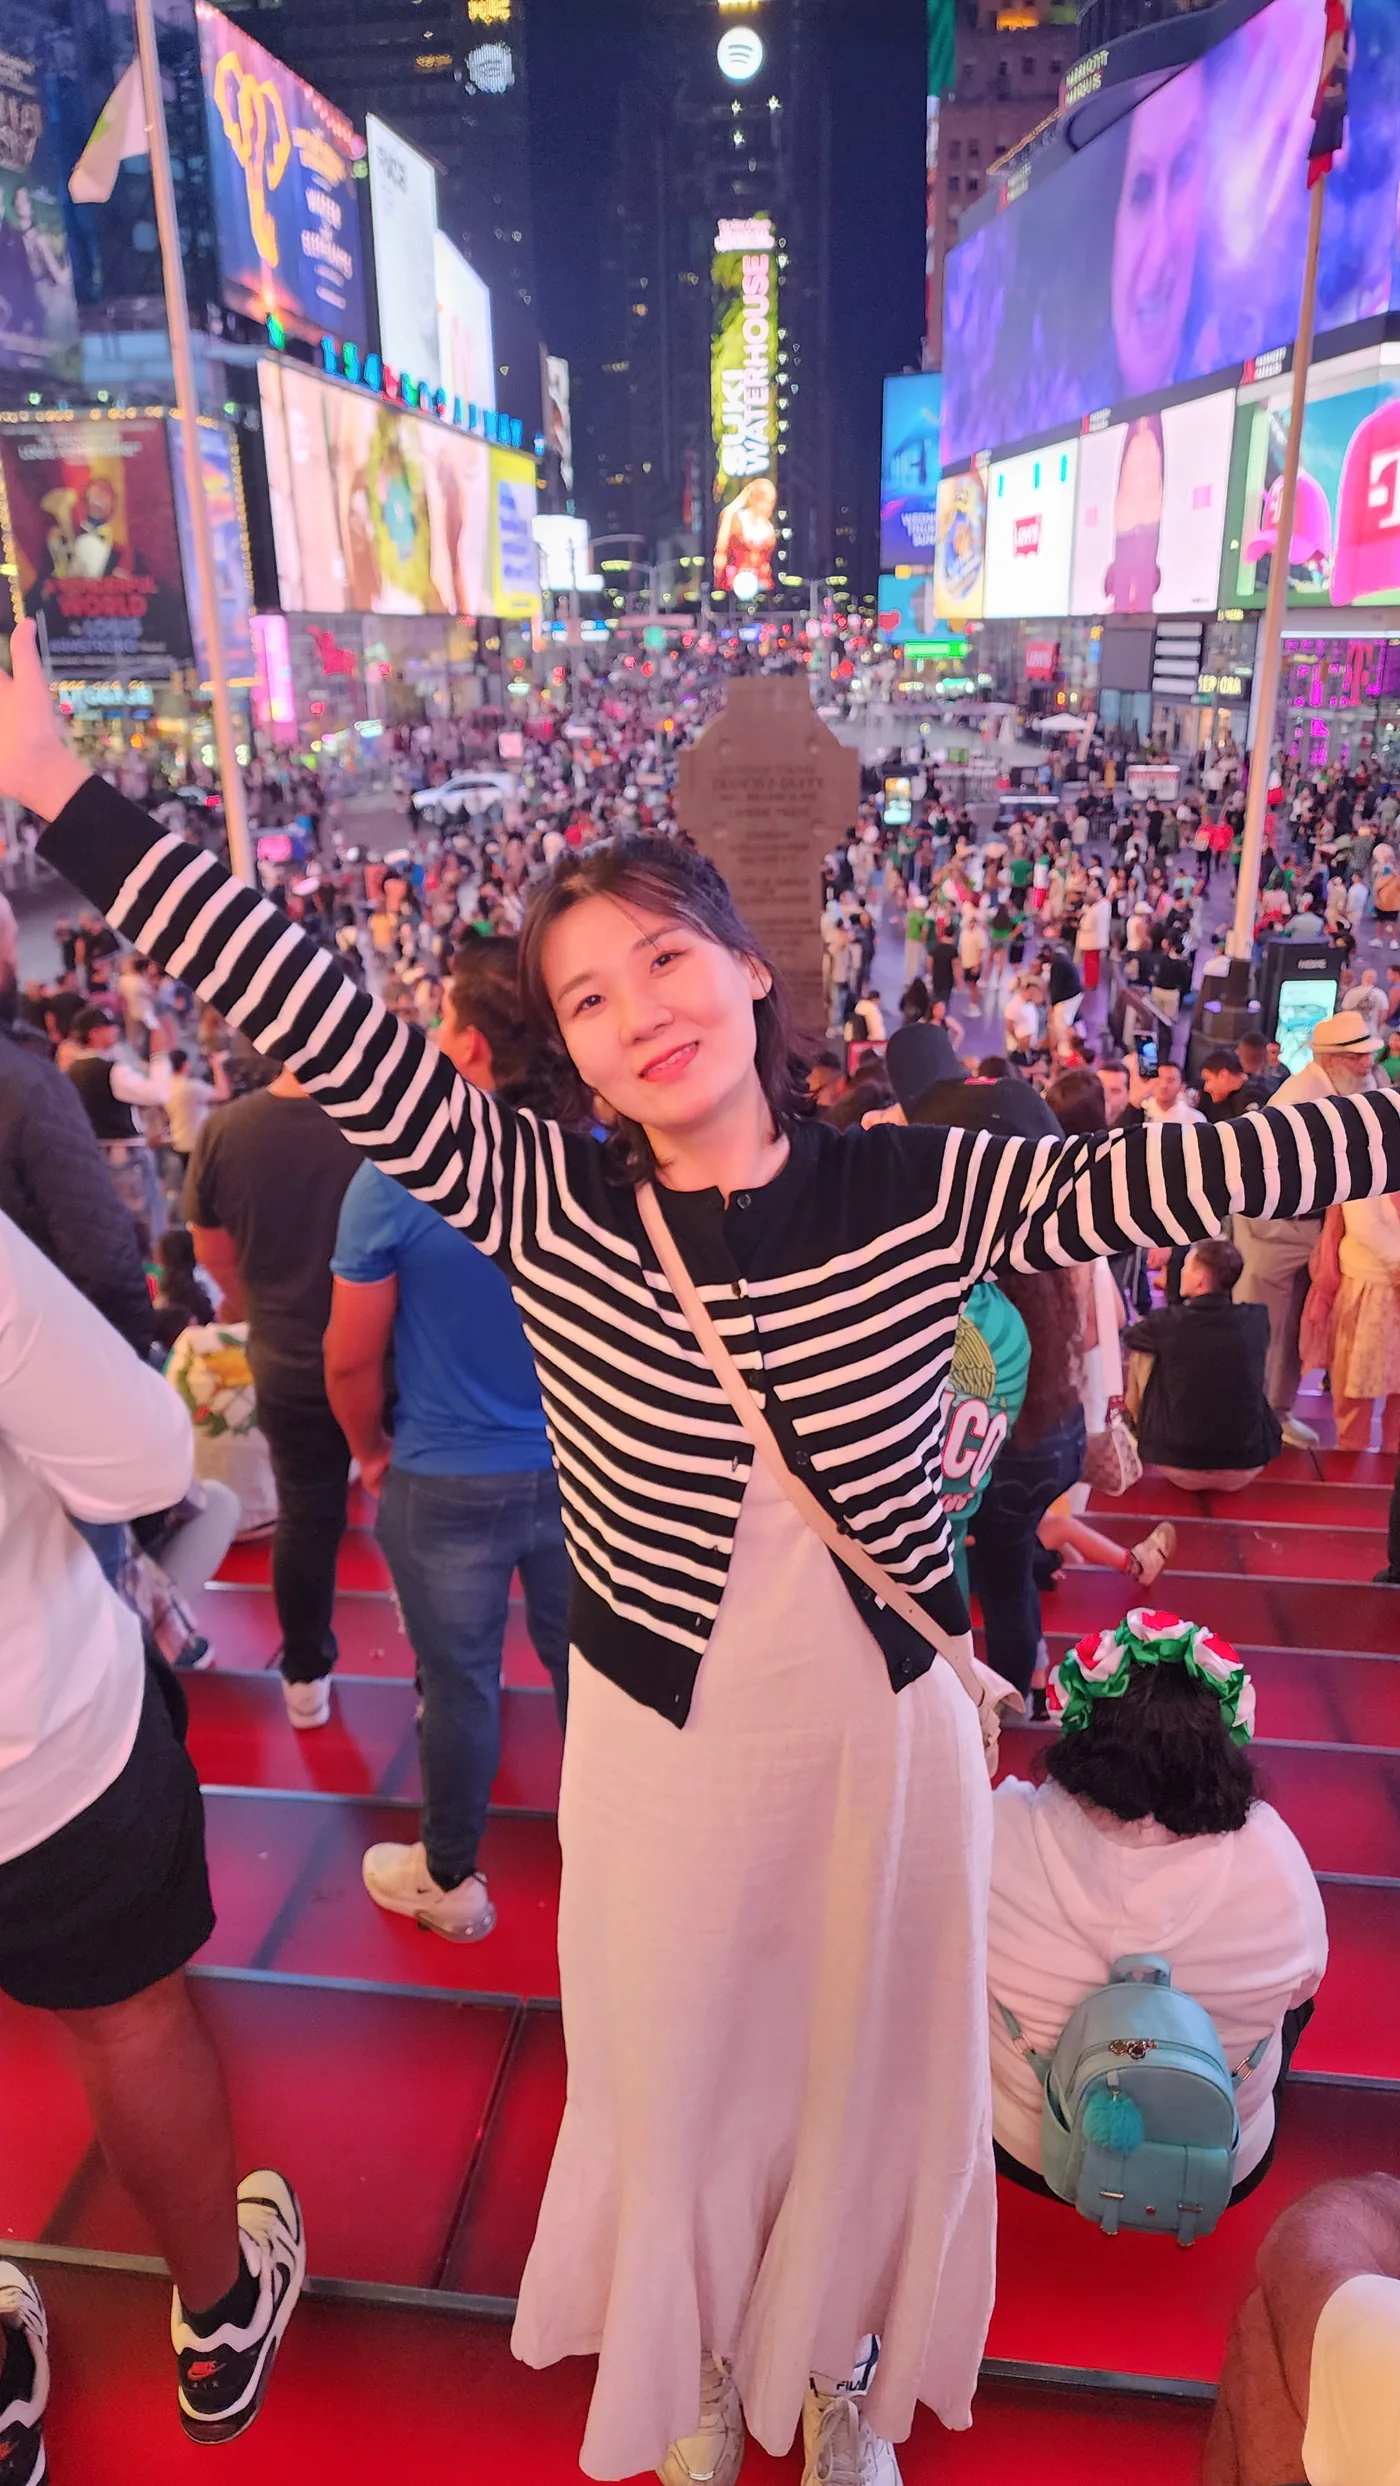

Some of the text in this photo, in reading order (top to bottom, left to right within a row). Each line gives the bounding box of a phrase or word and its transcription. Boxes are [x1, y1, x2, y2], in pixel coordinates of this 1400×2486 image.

[1065, 50, 1110, 90] MARRIOTT
[1065, 72, 1103, 107] MARQUIS
[742, 254, 770, 475] WATERHOUSE
[722, 369, 745, 476] SUKI
[58, 593, 147, 618] WORLD
